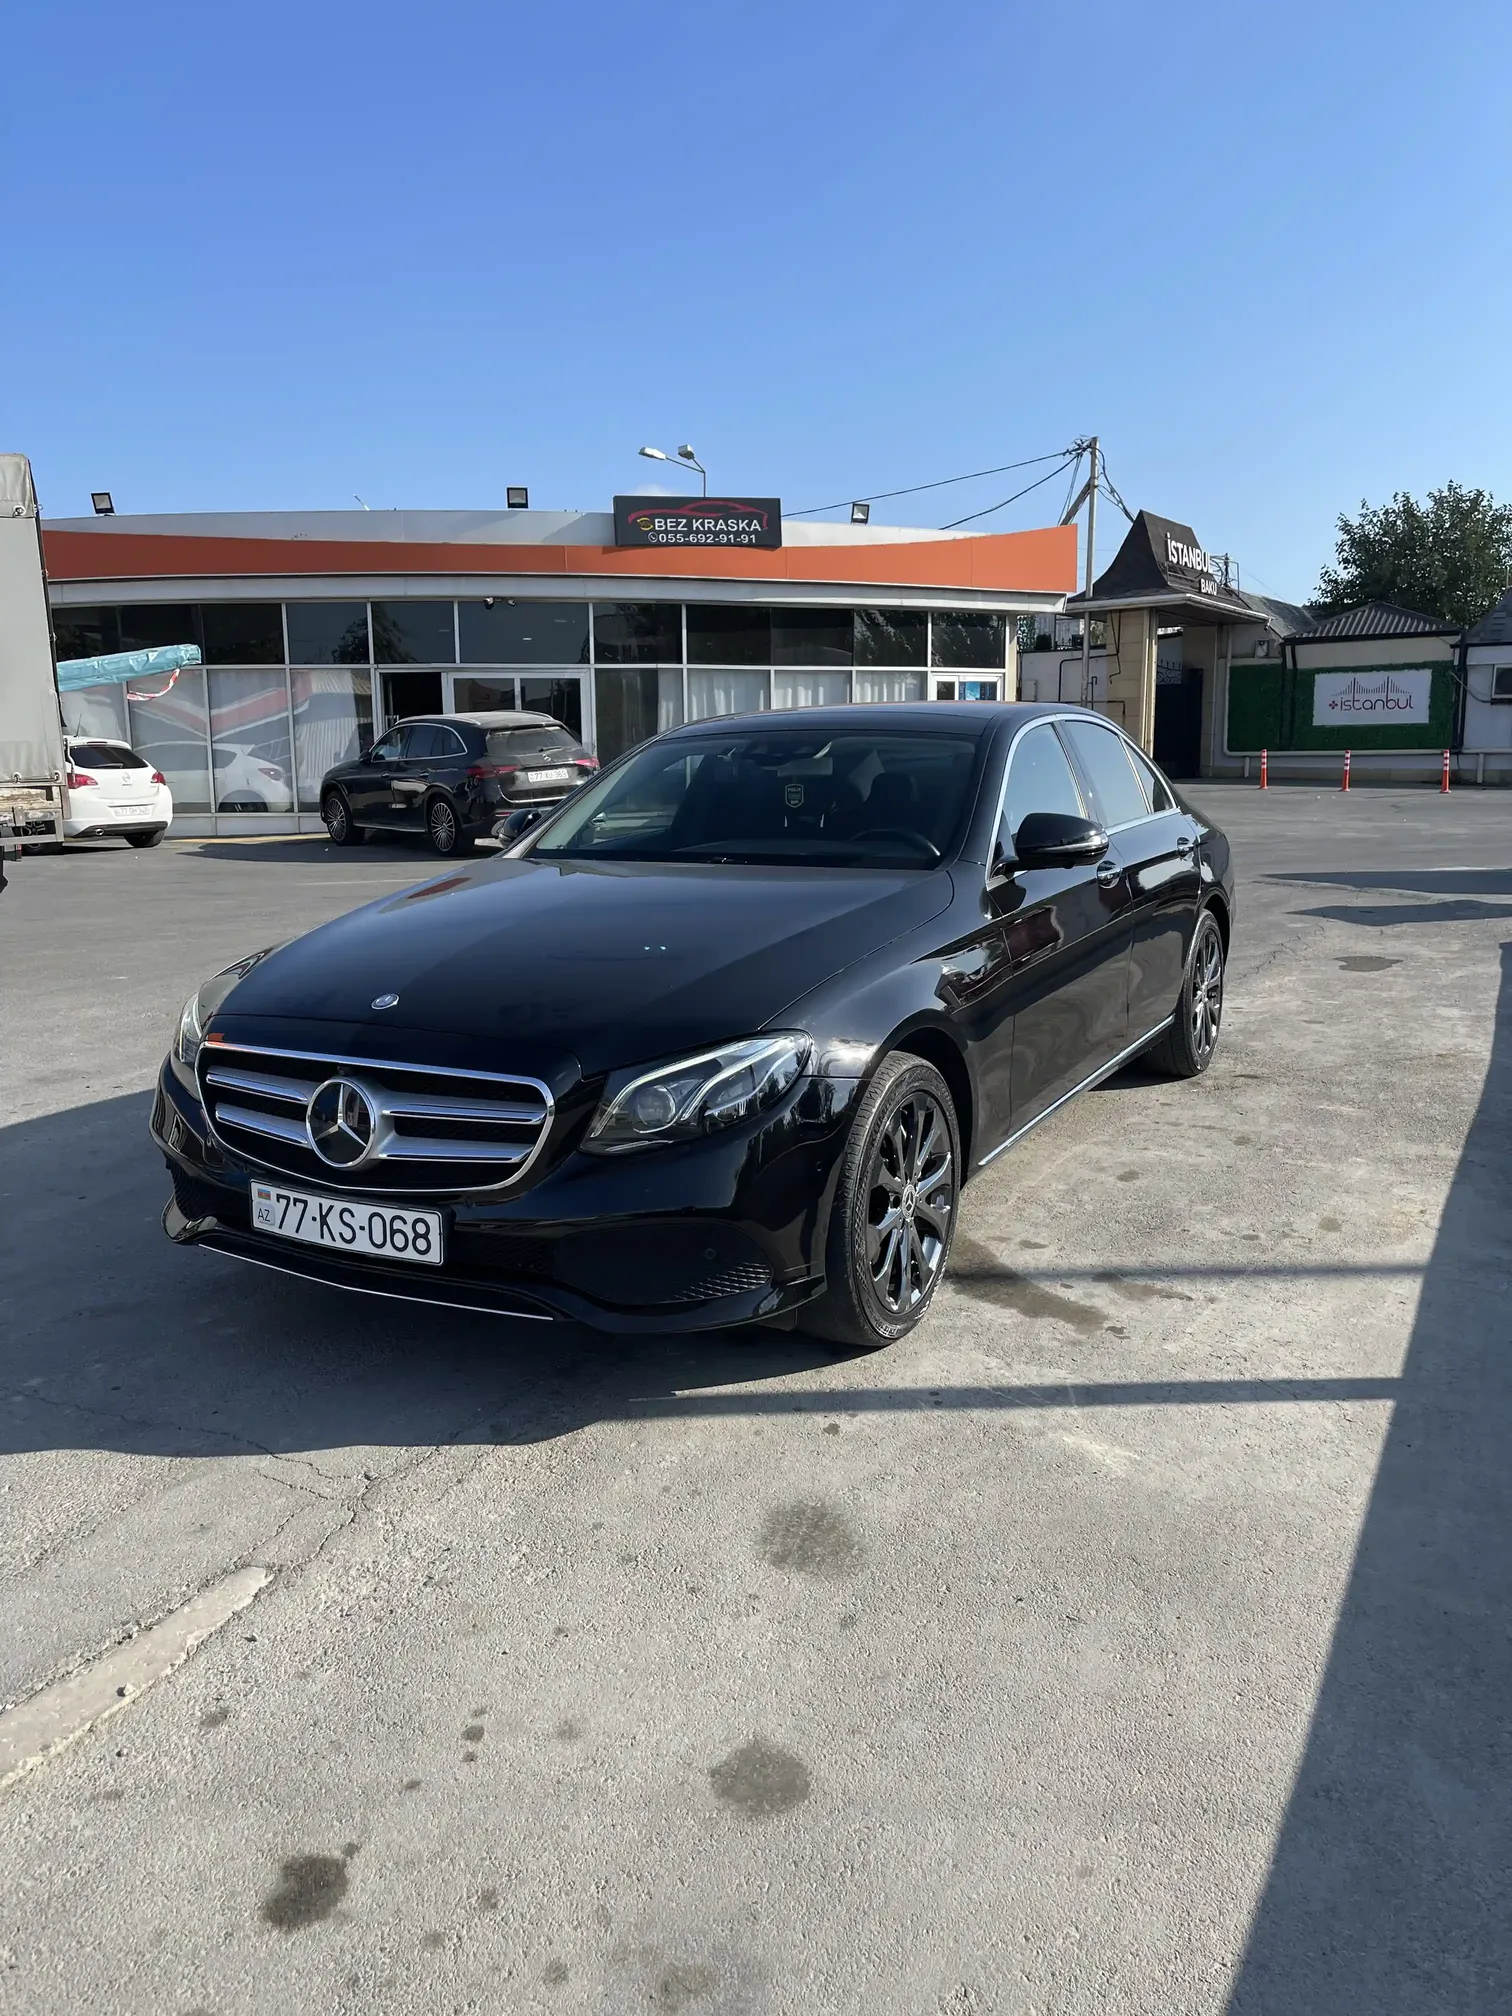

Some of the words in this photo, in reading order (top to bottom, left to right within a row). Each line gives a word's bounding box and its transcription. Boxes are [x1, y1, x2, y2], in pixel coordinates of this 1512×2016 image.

[654, 518, 688, 531] BEZ
[692, 518, 762, 532] KRASKA
[658, 533, 756, 543] 055-692-91-91
[1166, 532, 1213, 574] İSTANBUL
[1200, 578, 1218, 596] BAKU
[257, 1207, 271, 1222] AZ
[276, 1193, 432, 1256] 77-KS-068
